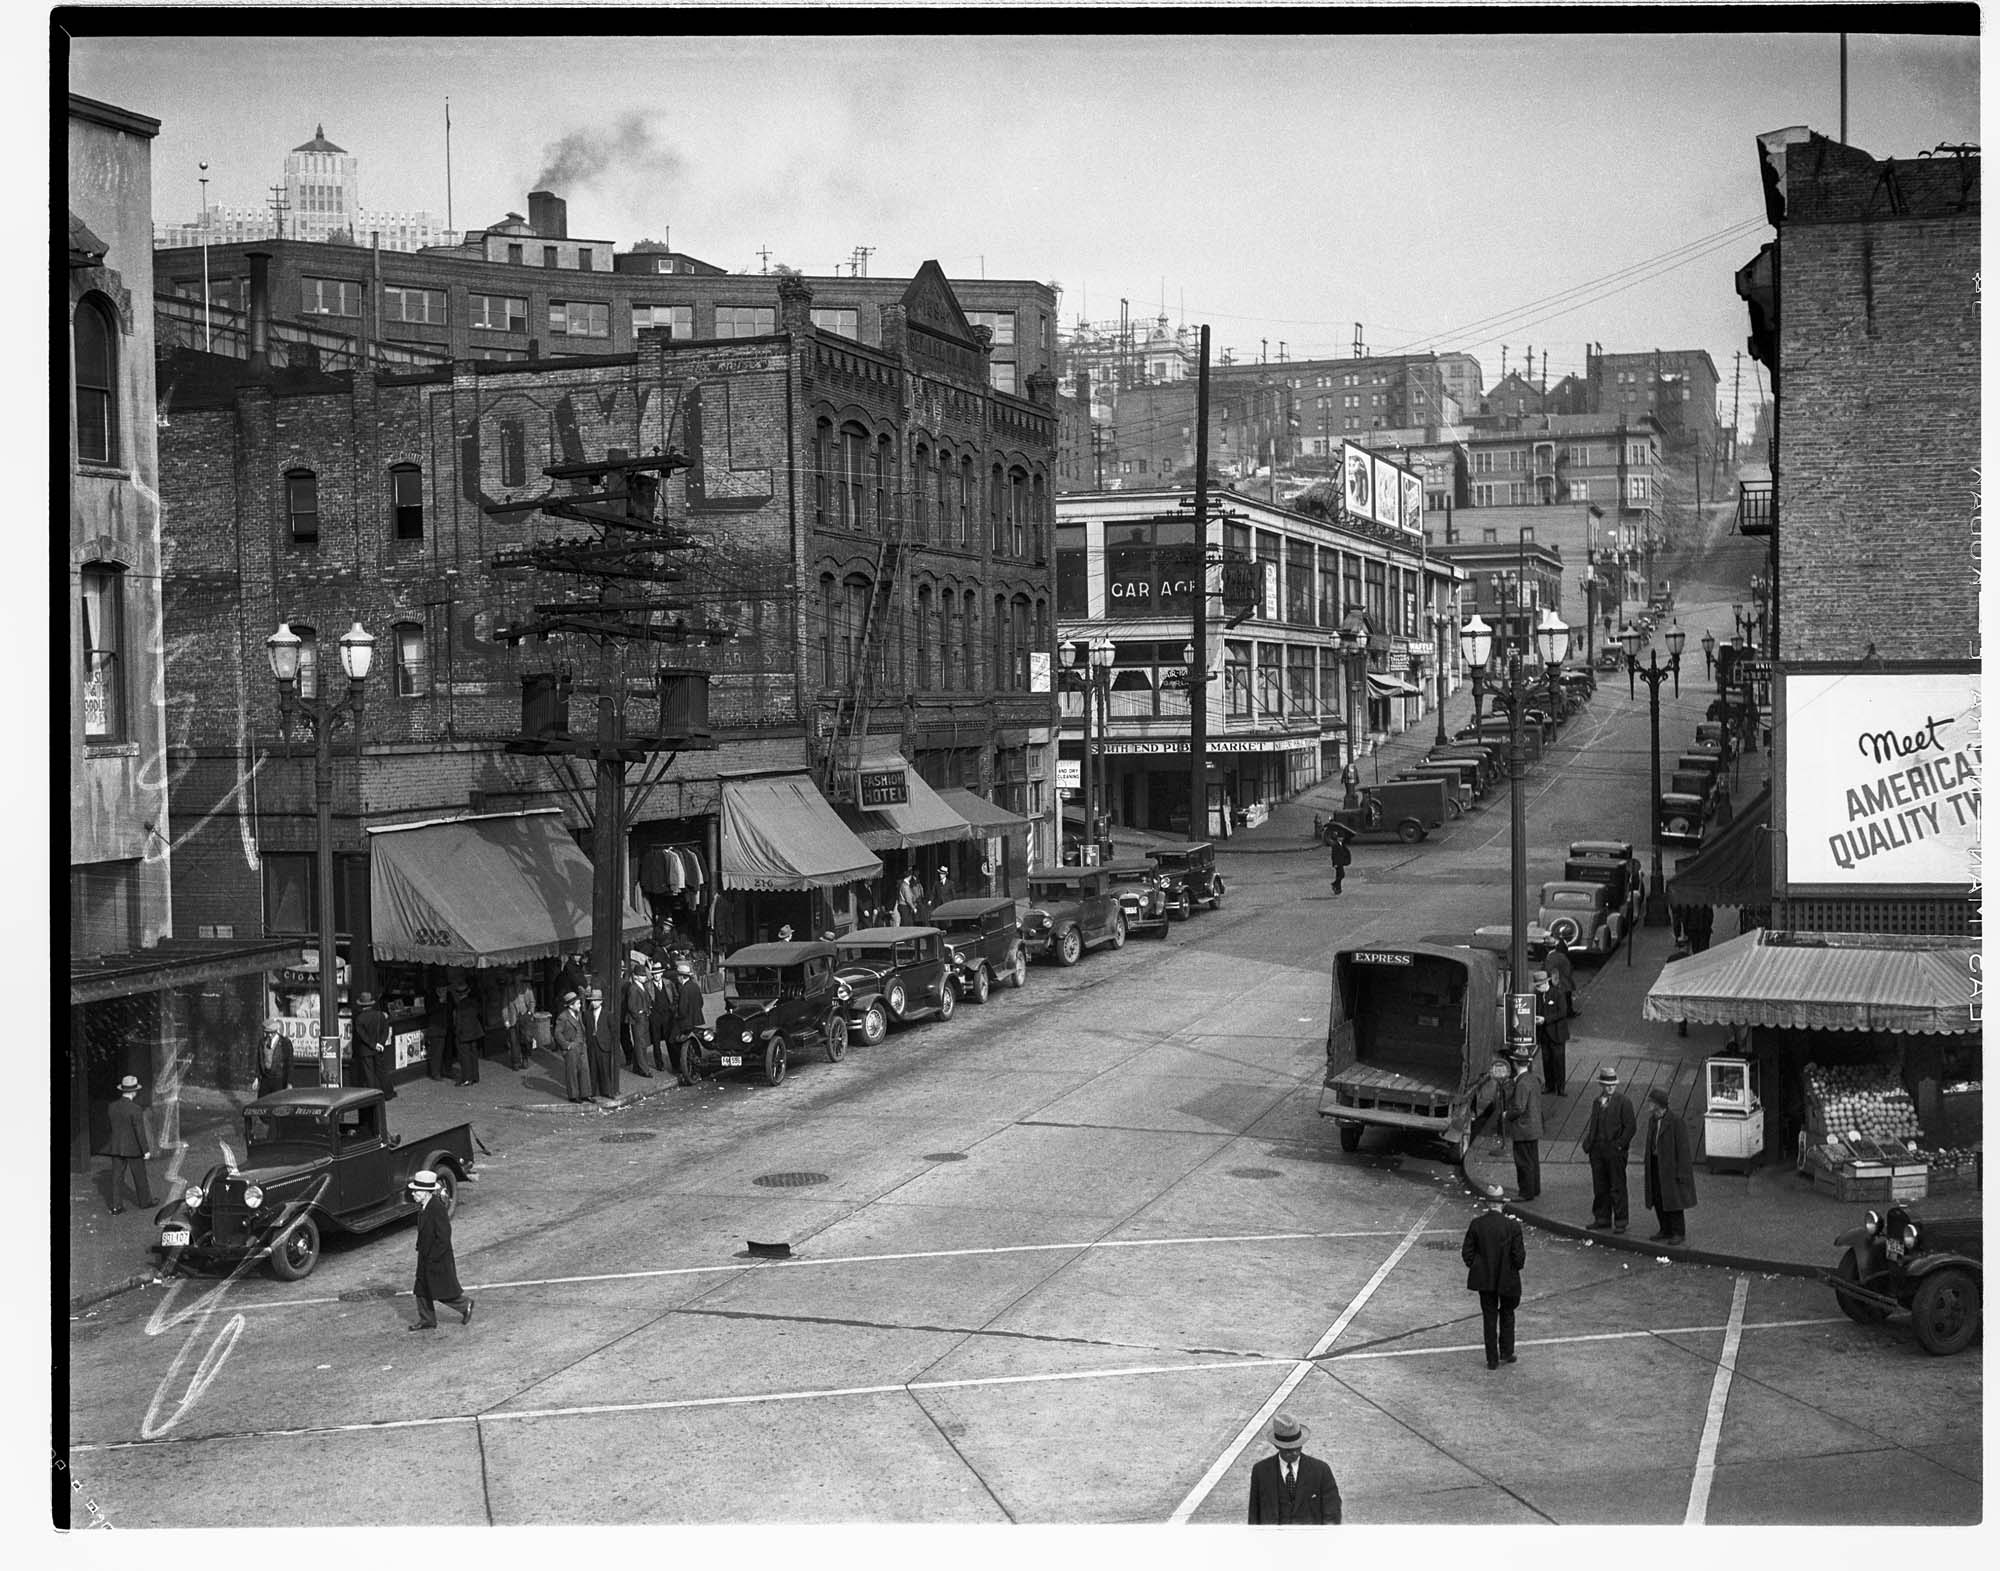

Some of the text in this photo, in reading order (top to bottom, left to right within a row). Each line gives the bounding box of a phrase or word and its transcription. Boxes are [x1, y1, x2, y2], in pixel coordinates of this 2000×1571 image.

[1134, 743, 1159, 753] END
[1211, 743, 1265, 753] MARKET
[1859, 715, 1955, 764] Meet
[863, 772, 904, 787] FASHION
[1846, 750, 1981, 822] AMERICA
[864, 787, 906, 804] HOTEL
[1828, 801, 1940, 869] QUALITY
[1355, 952, 1410, 965] EXPRESS
